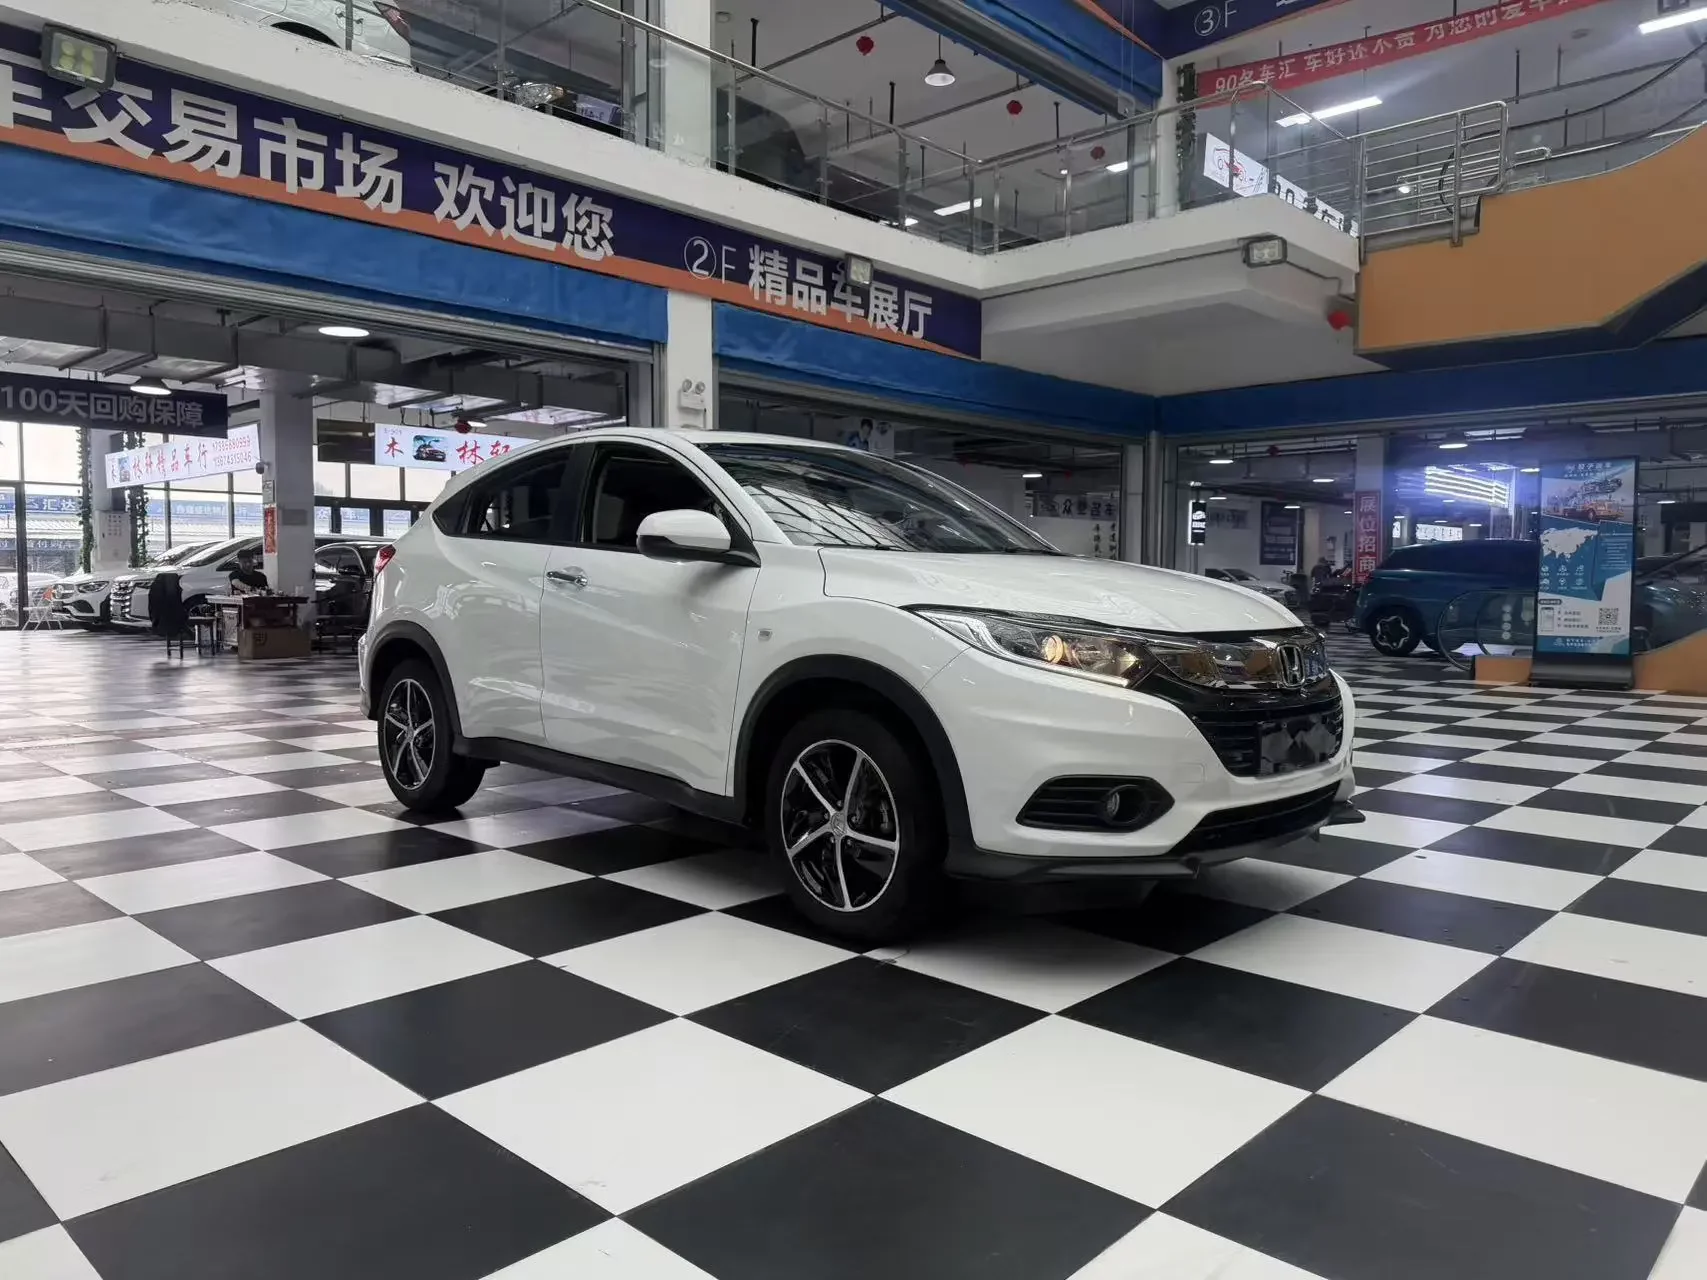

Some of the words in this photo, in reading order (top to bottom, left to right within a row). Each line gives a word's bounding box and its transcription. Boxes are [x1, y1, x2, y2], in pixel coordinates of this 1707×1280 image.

[433, 161, 616, 262] 欢迎您
[747, 243, 934, 340] 精品车展厅
[0, 385, 204, 428] 100天回购保障
[384, 436, 404, 459] 木
[1358, 495, 1377, 574] 展位招商
